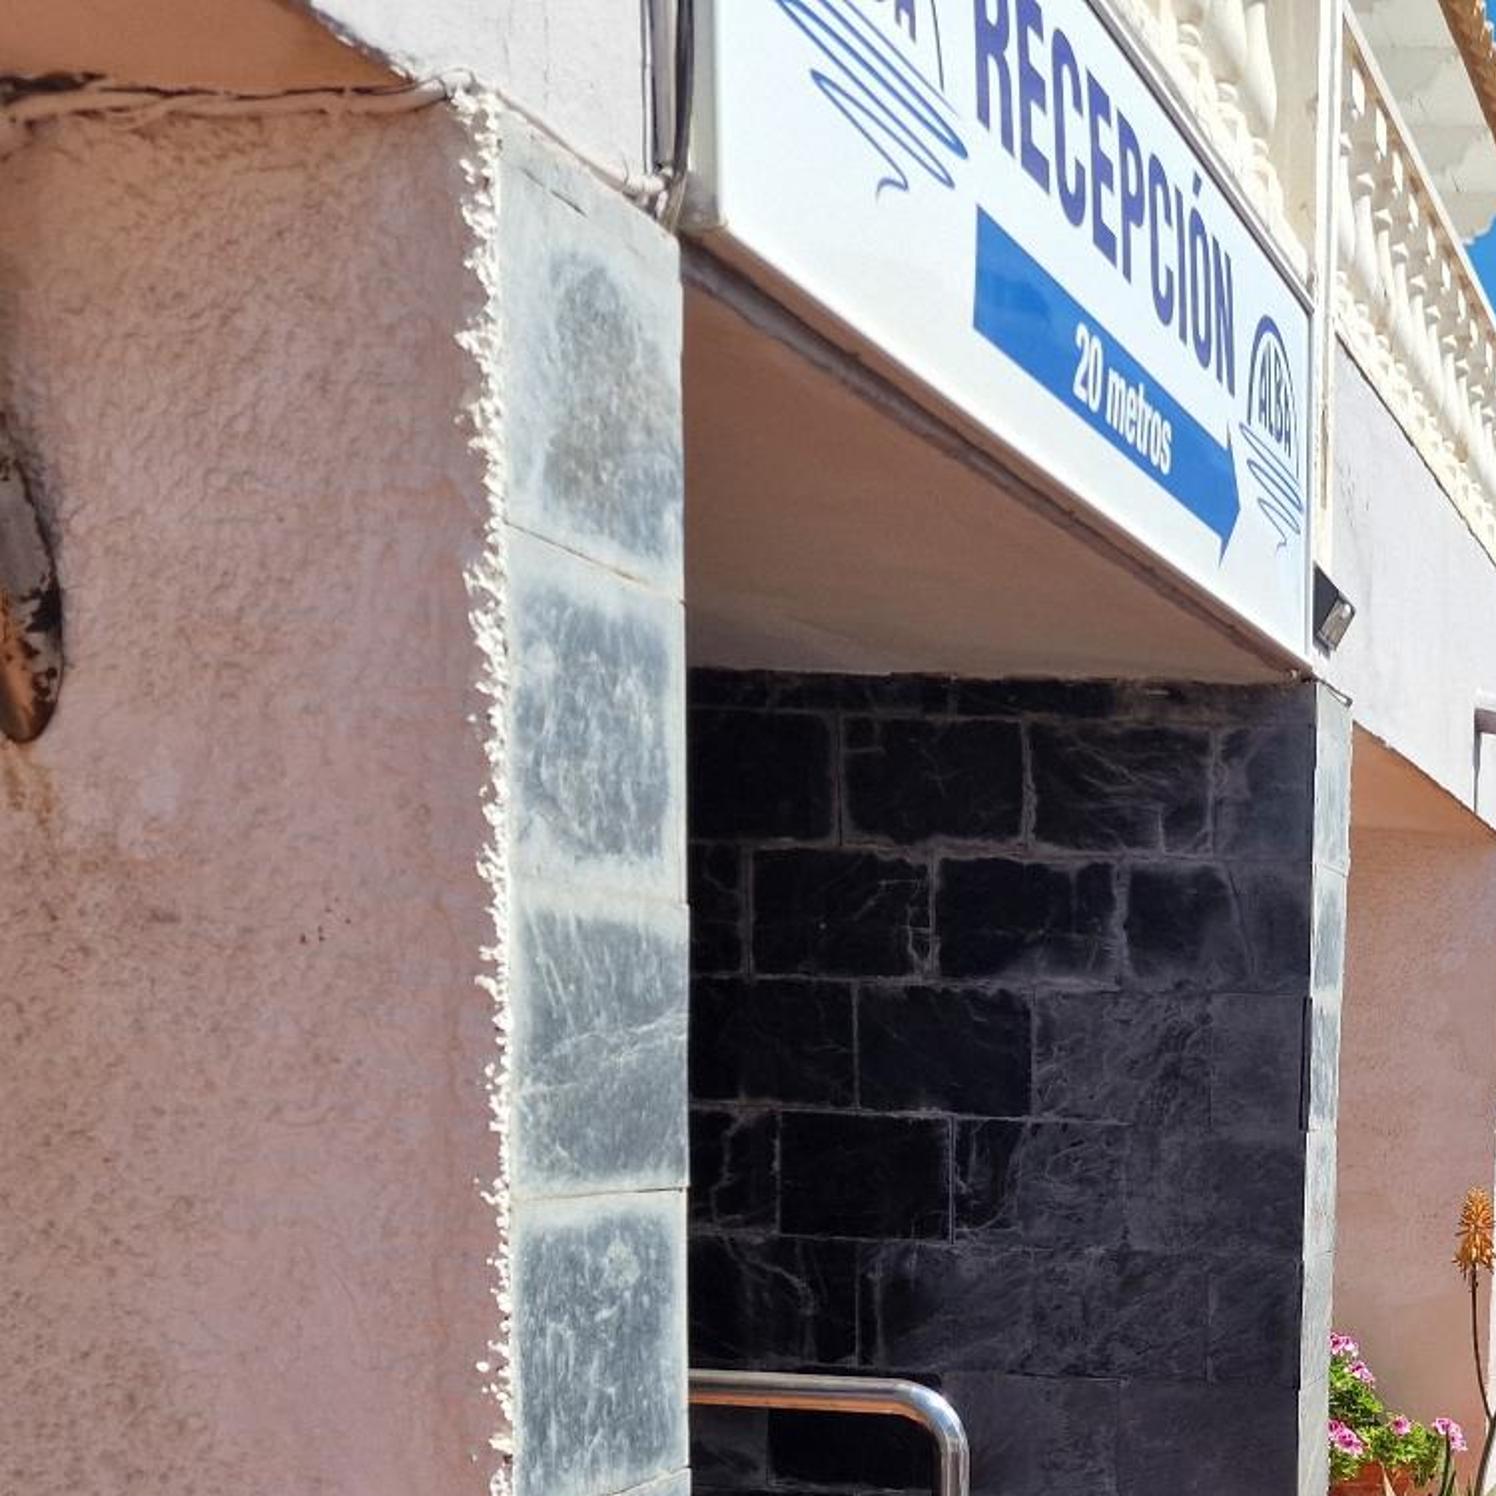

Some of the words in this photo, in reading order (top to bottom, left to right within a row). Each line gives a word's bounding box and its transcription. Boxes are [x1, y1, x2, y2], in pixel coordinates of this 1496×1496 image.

[974, 0, 1236, 397] RECEPCIÓN
[1073, 322, 1104, 412] 20
[1105, 366, 1172, 475] metros
[1259, 341, 1291, 458] ALBA
